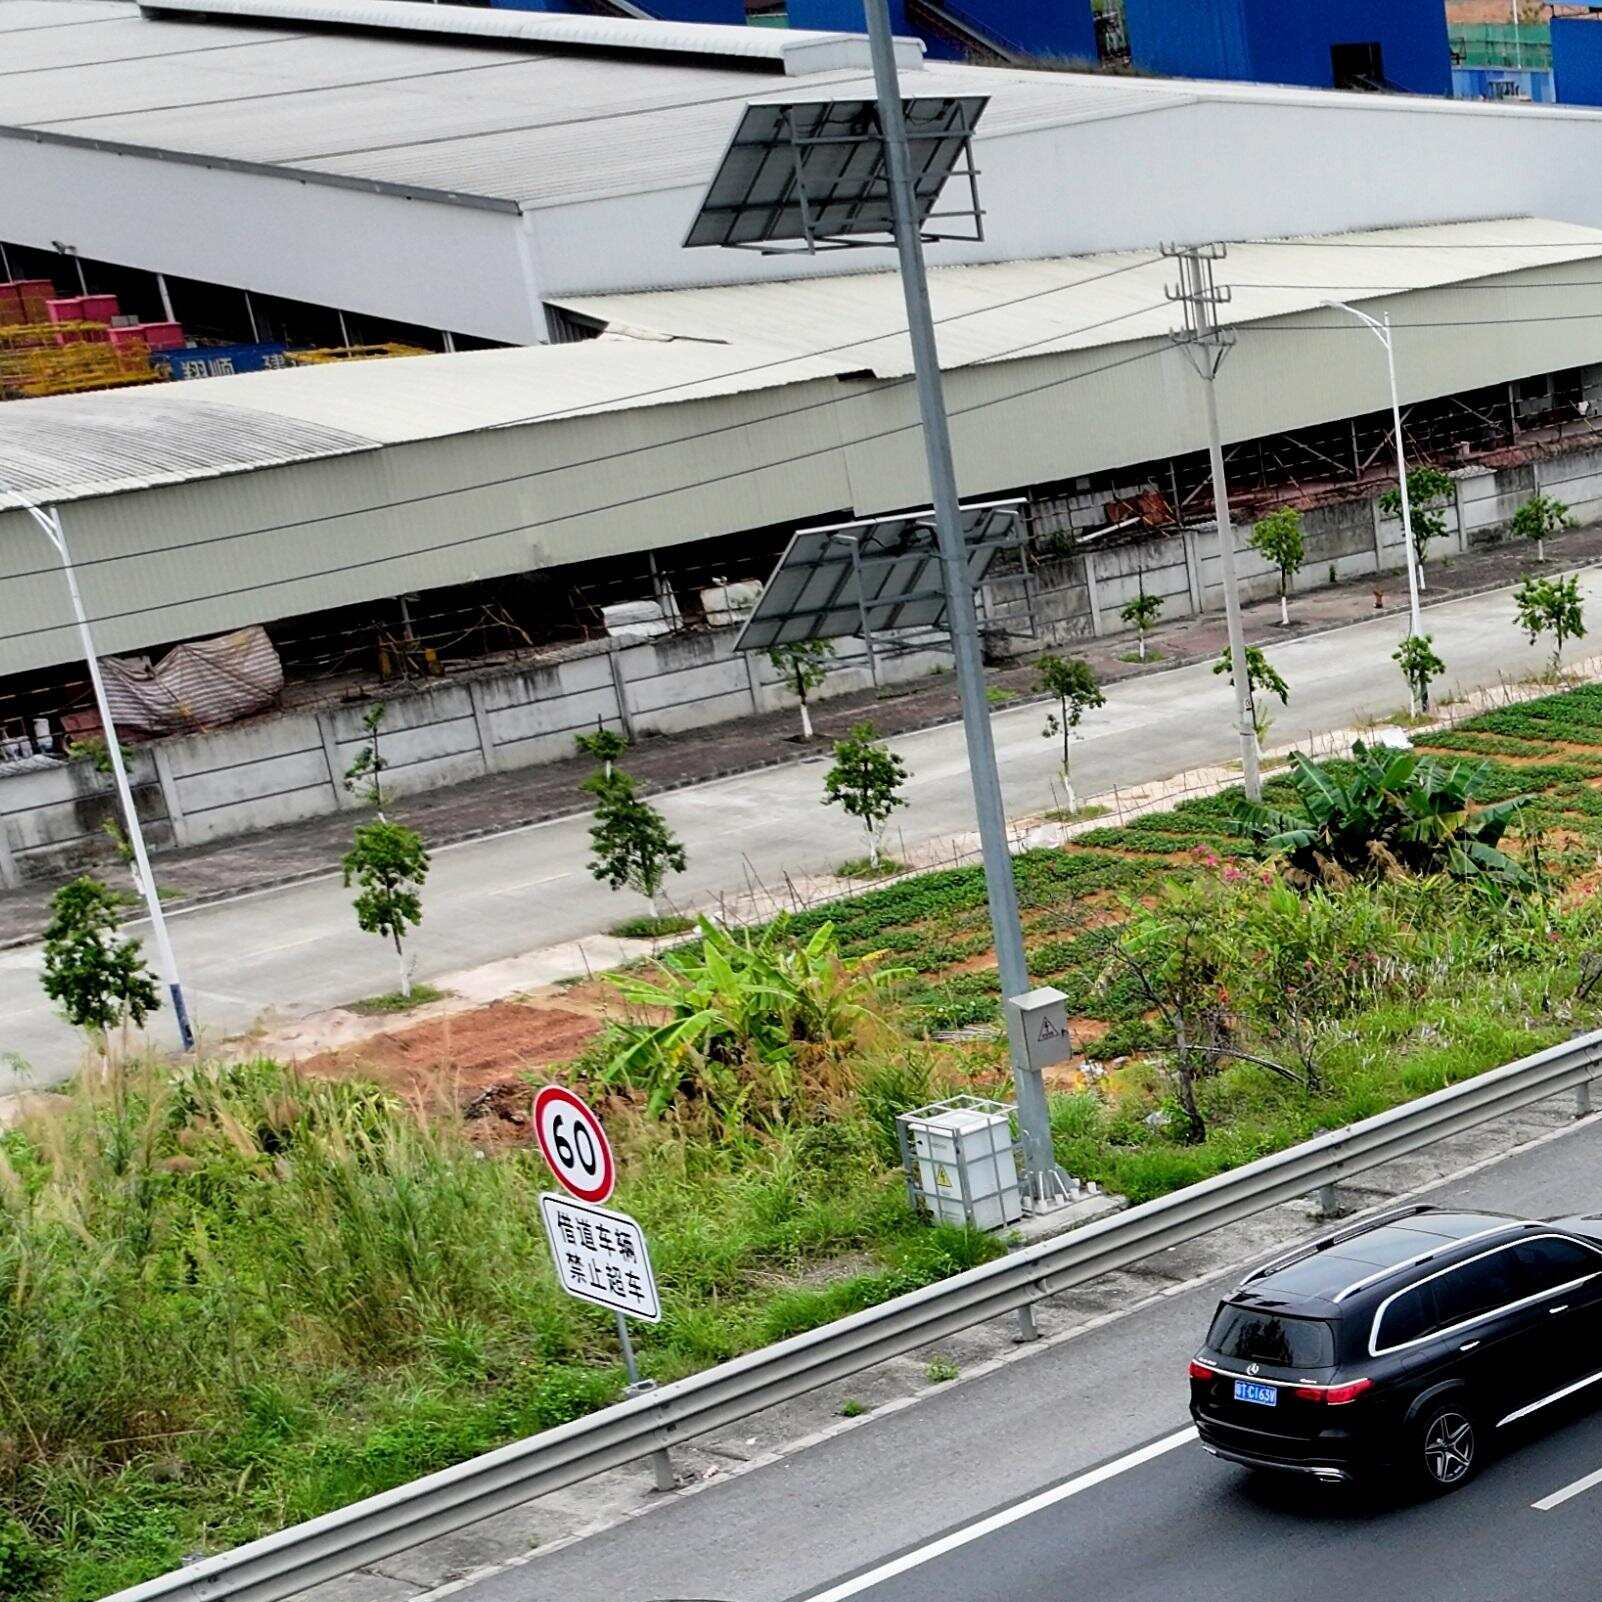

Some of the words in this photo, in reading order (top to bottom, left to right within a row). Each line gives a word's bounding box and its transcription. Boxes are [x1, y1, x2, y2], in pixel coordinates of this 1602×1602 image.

[552, 1114, 596, 1176] 60
[566, 1252, 645, 1304] 禁止超车
